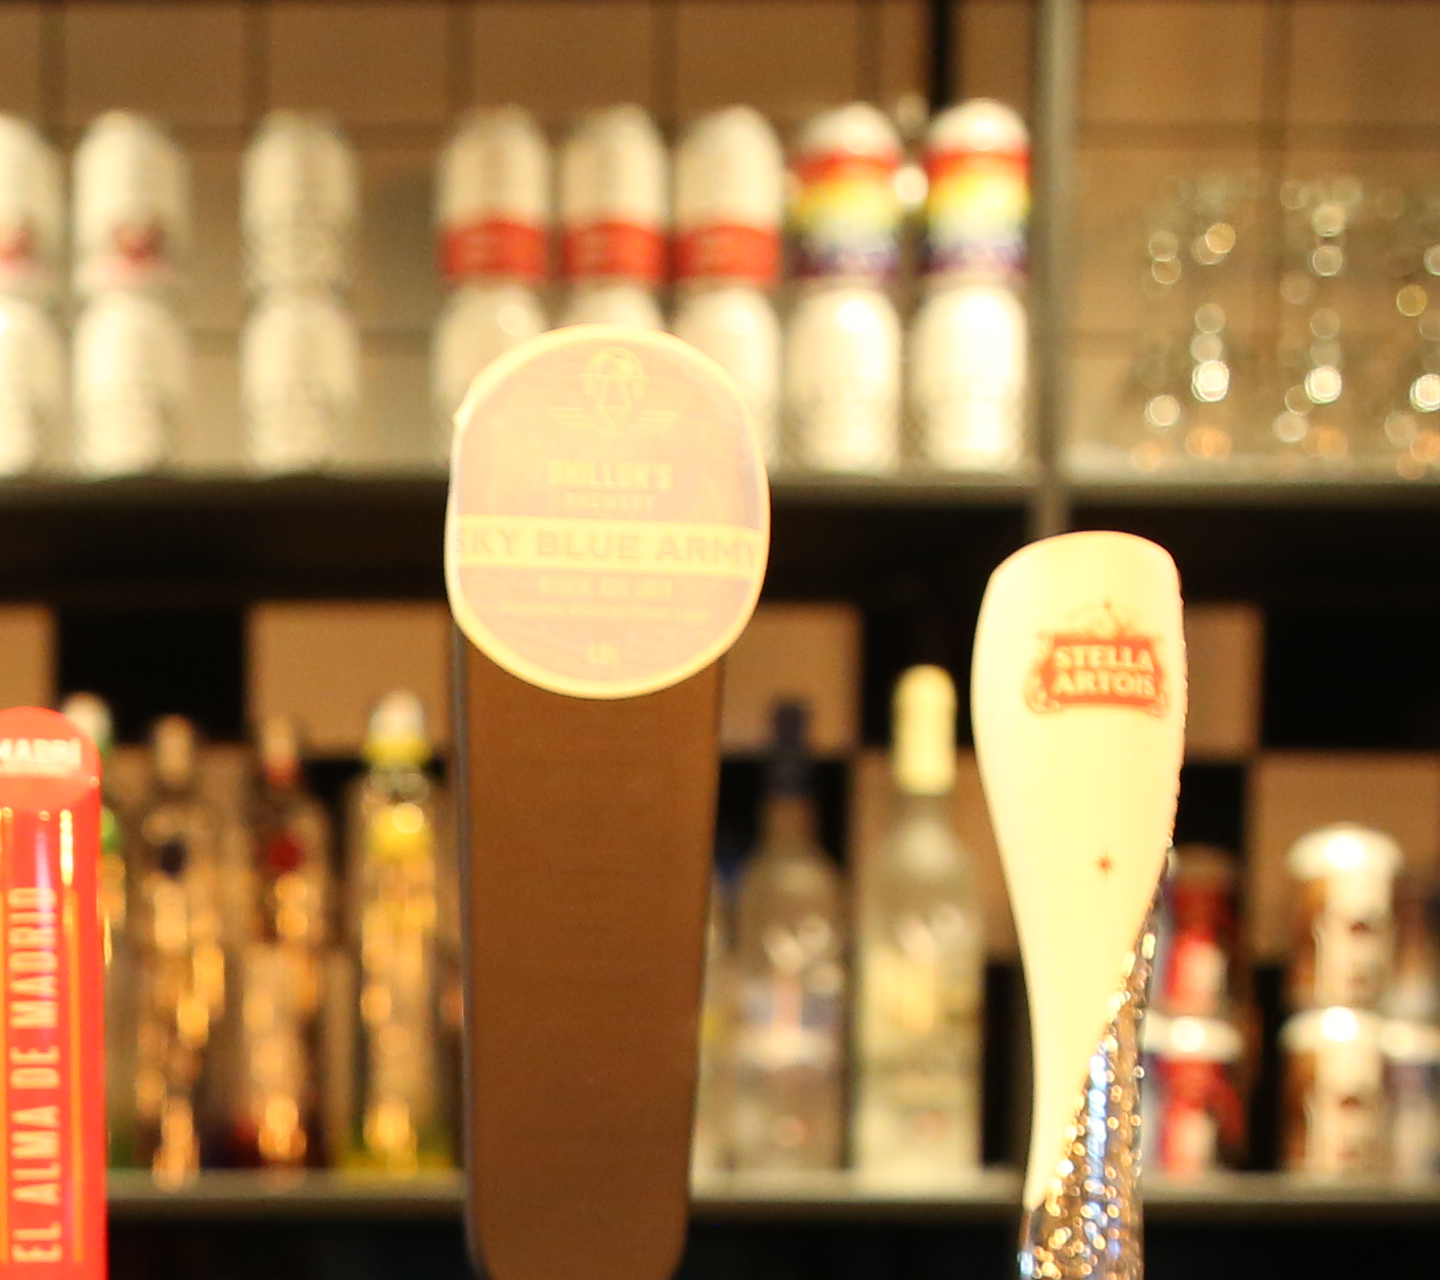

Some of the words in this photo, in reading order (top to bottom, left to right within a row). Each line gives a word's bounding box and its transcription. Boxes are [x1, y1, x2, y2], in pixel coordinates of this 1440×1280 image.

[536, 531, 641, 559] BLUE
[1052, 644, 1155, 673] STELLA
[1052, 670, 1157, 697] ARTOIS
[8, 887, 60, 1029] MADRID
[10, 1044, 62, 1089] DE
[10, 1104, 63, 1207] ALMA
[10, 1220, 64, 1264] EL
